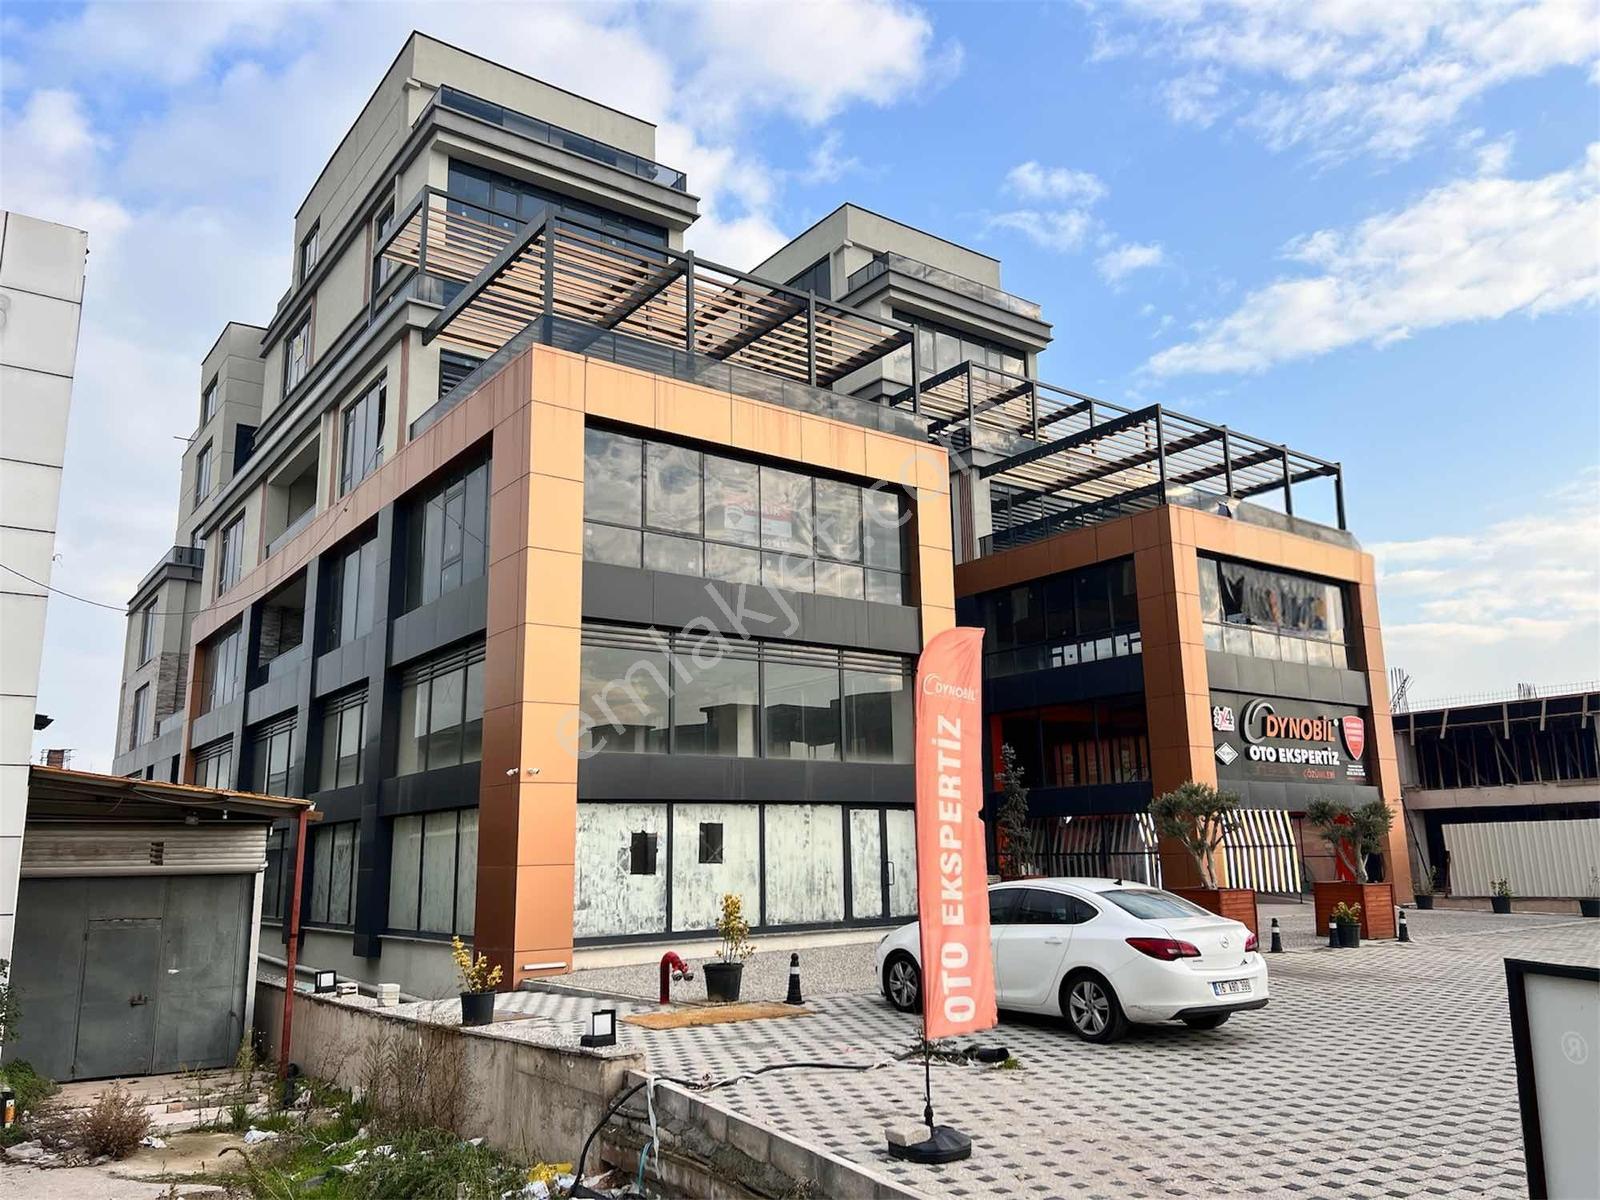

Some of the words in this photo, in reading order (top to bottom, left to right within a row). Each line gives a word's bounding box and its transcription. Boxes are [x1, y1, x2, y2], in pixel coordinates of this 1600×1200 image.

[1250, 745, 1277, 762] OTO
[1278, 747, 1340, 766] EKSPERTİZ
[1266, 715, 1335, 742] DYNOBİL
[931, 714, 965, 925] EKSPERTİZ
[941, 942, 976, 1023] OTO
